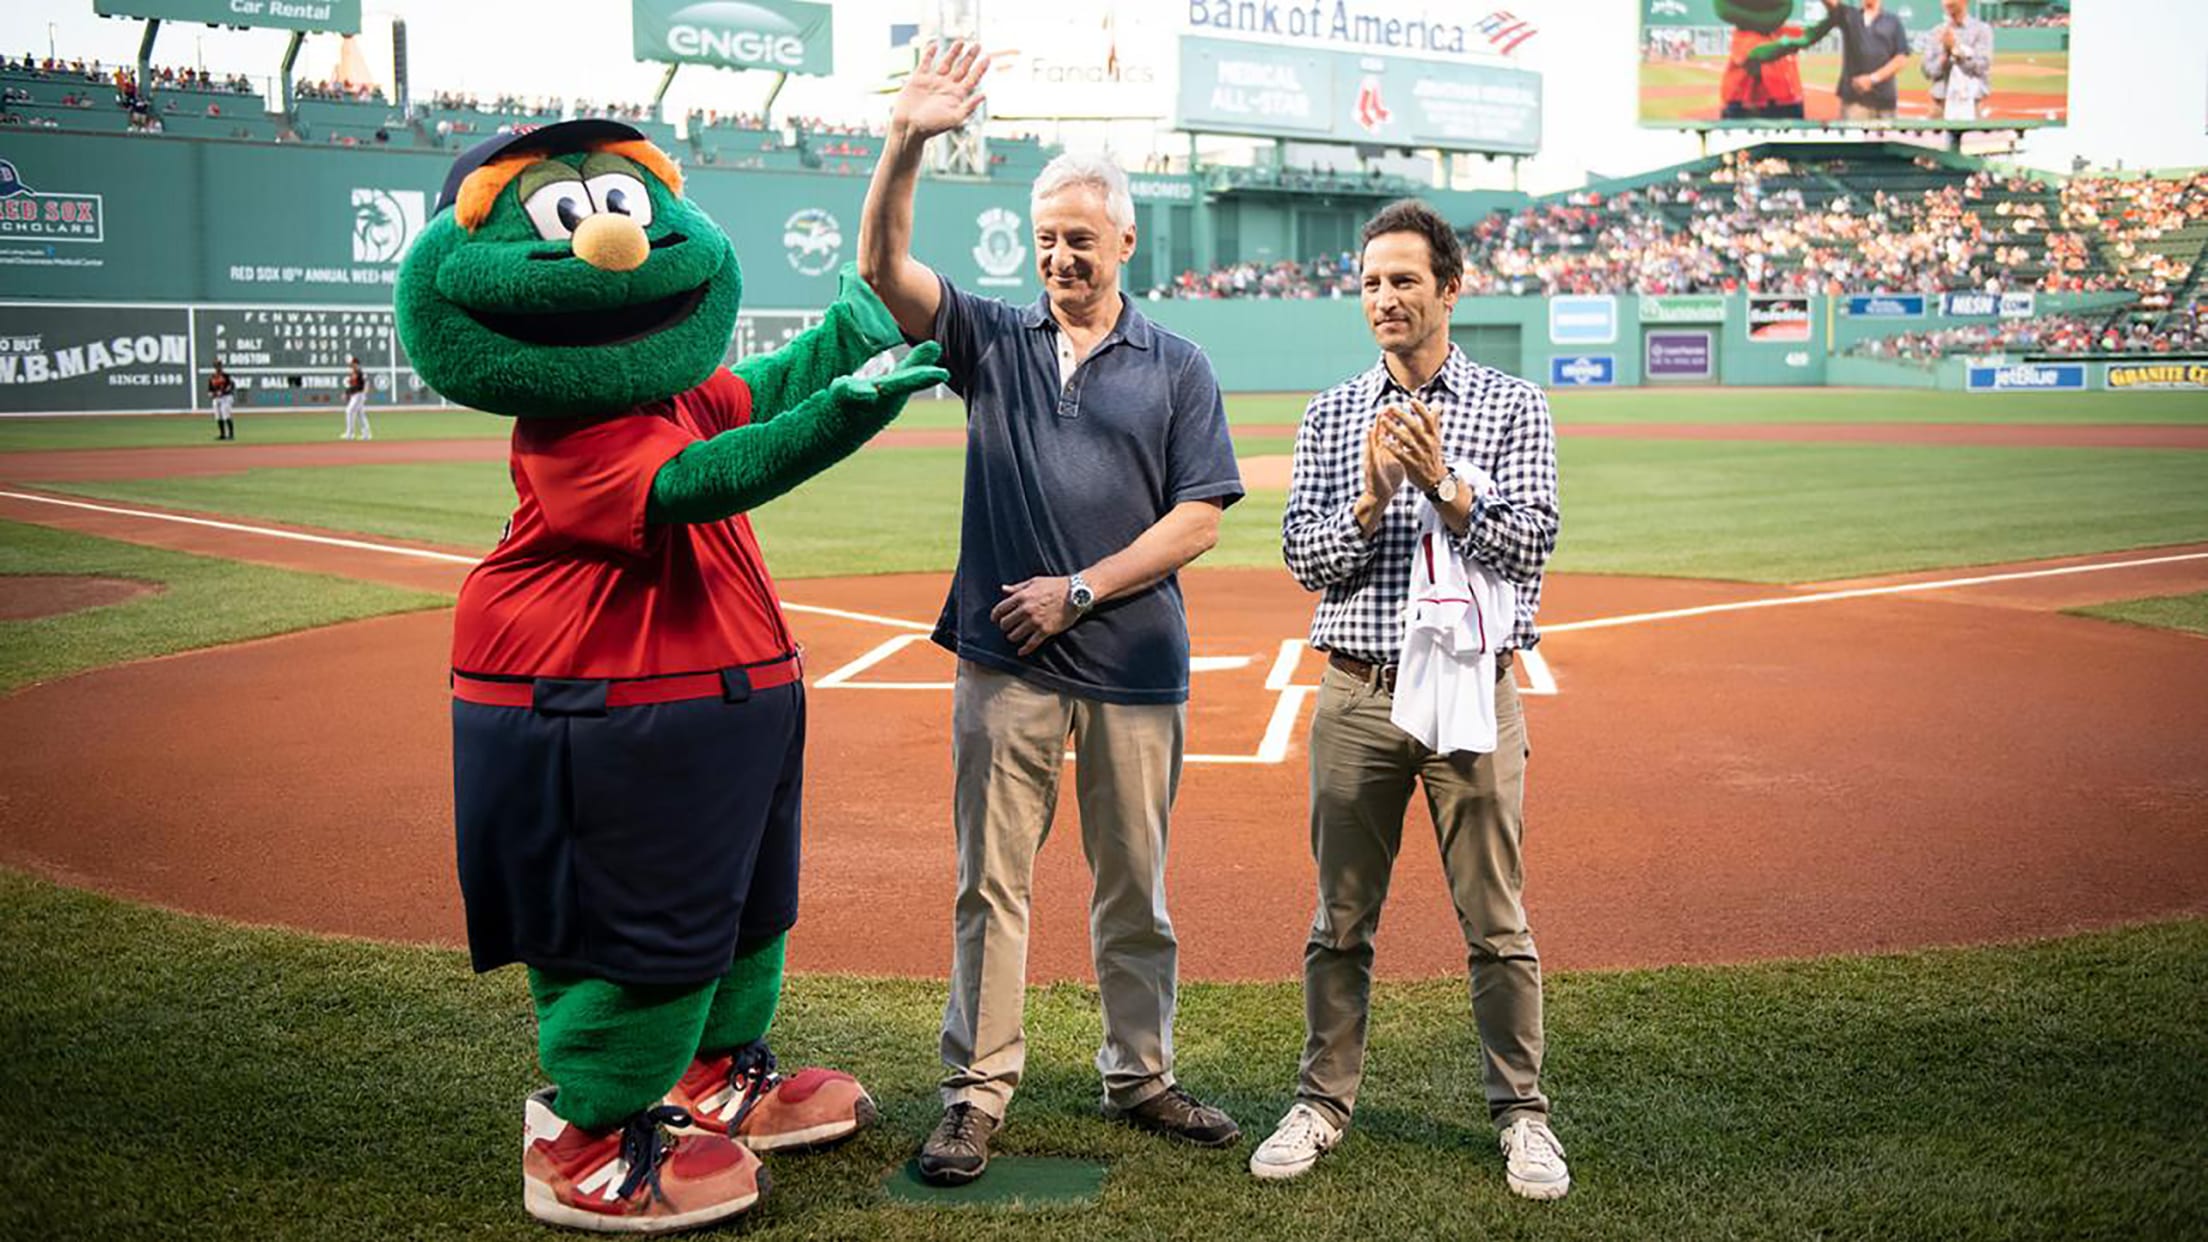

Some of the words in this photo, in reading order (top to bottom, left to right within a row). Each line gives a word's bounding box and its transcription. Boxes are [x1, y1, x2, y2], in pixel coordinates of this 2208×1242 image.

[229, 0, 264, 14] Car
[269, 3, 331, 20] Rental
[1188, 0, 1284, 35] Bank
[1288, 2, 1323, 38] of
[1328, 0, 1466, 53] America
[0, 199, 37, 221] ED
[44, 201, 94, 222] SOX
[1, 222, 96, 234] CHOLARS
[230, 265, 255, 281] RED
[256, 266, 281, 282] SOX
[304, 268, 350, 283] ANNUAL
[244, 312, 327, 324] FENWAY
[341, 313, 393, 324] PARK
[12, 338, 42, 352] BUT
[108, 373, 152, 386] SINCE
